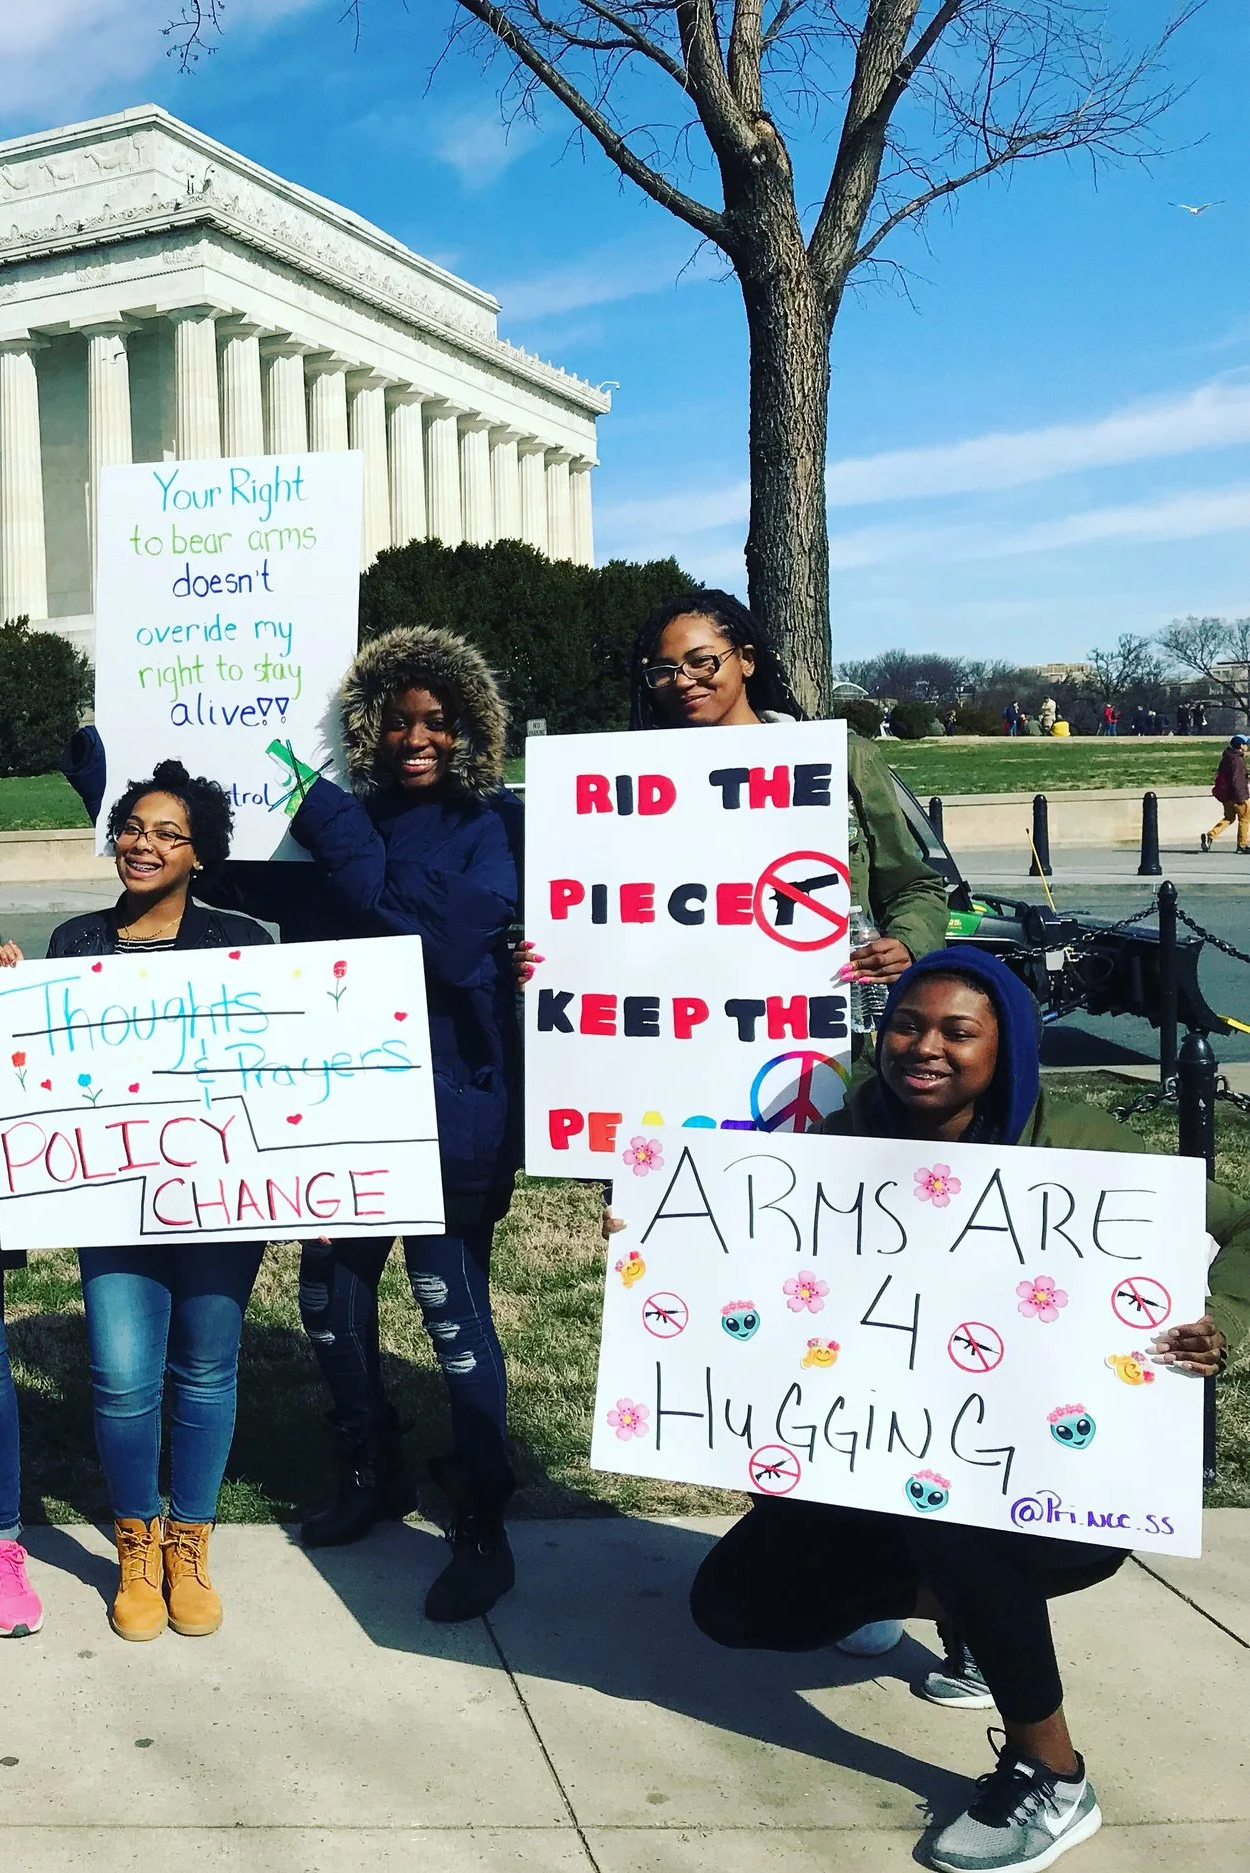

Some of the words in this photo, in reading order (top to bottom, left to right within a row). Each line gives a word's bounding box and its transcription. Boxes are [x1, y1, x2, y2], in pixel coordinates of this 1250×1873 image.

[153, 468, 222, 512] Your
[230, 465, 309, 522] Right
[129, 524, 163, 556] to
[171, 524, 232, 555] bear
[247, 525, 317, 551] arms
[172, 558, 275, 598] doesn't
[136, 613, 237, 647] overide
[253, 617, 293, 658] my
[138, 655, 205, 703] right
[216, 655, 243, 683] to
[253, 652, 303, 700] stay
[576, 773, 677, 816] RID
[708, 763, 833, 810] THE
[548, 878, 756, 926] PIECE
[0, 976, 270, 1072] Thoughts
[537, 988, 710, 1040] KEEP
[724, 995, 848, 1043] THE
[1, 1114, 236, 1192] POLICY
[152, 1170, 390, 1228] CHANGE
[640, 1146, 908, 1256] ARMS
[949, 1167, 1157, 1265] ARE
[860, 1274, 921, 1370] 4
